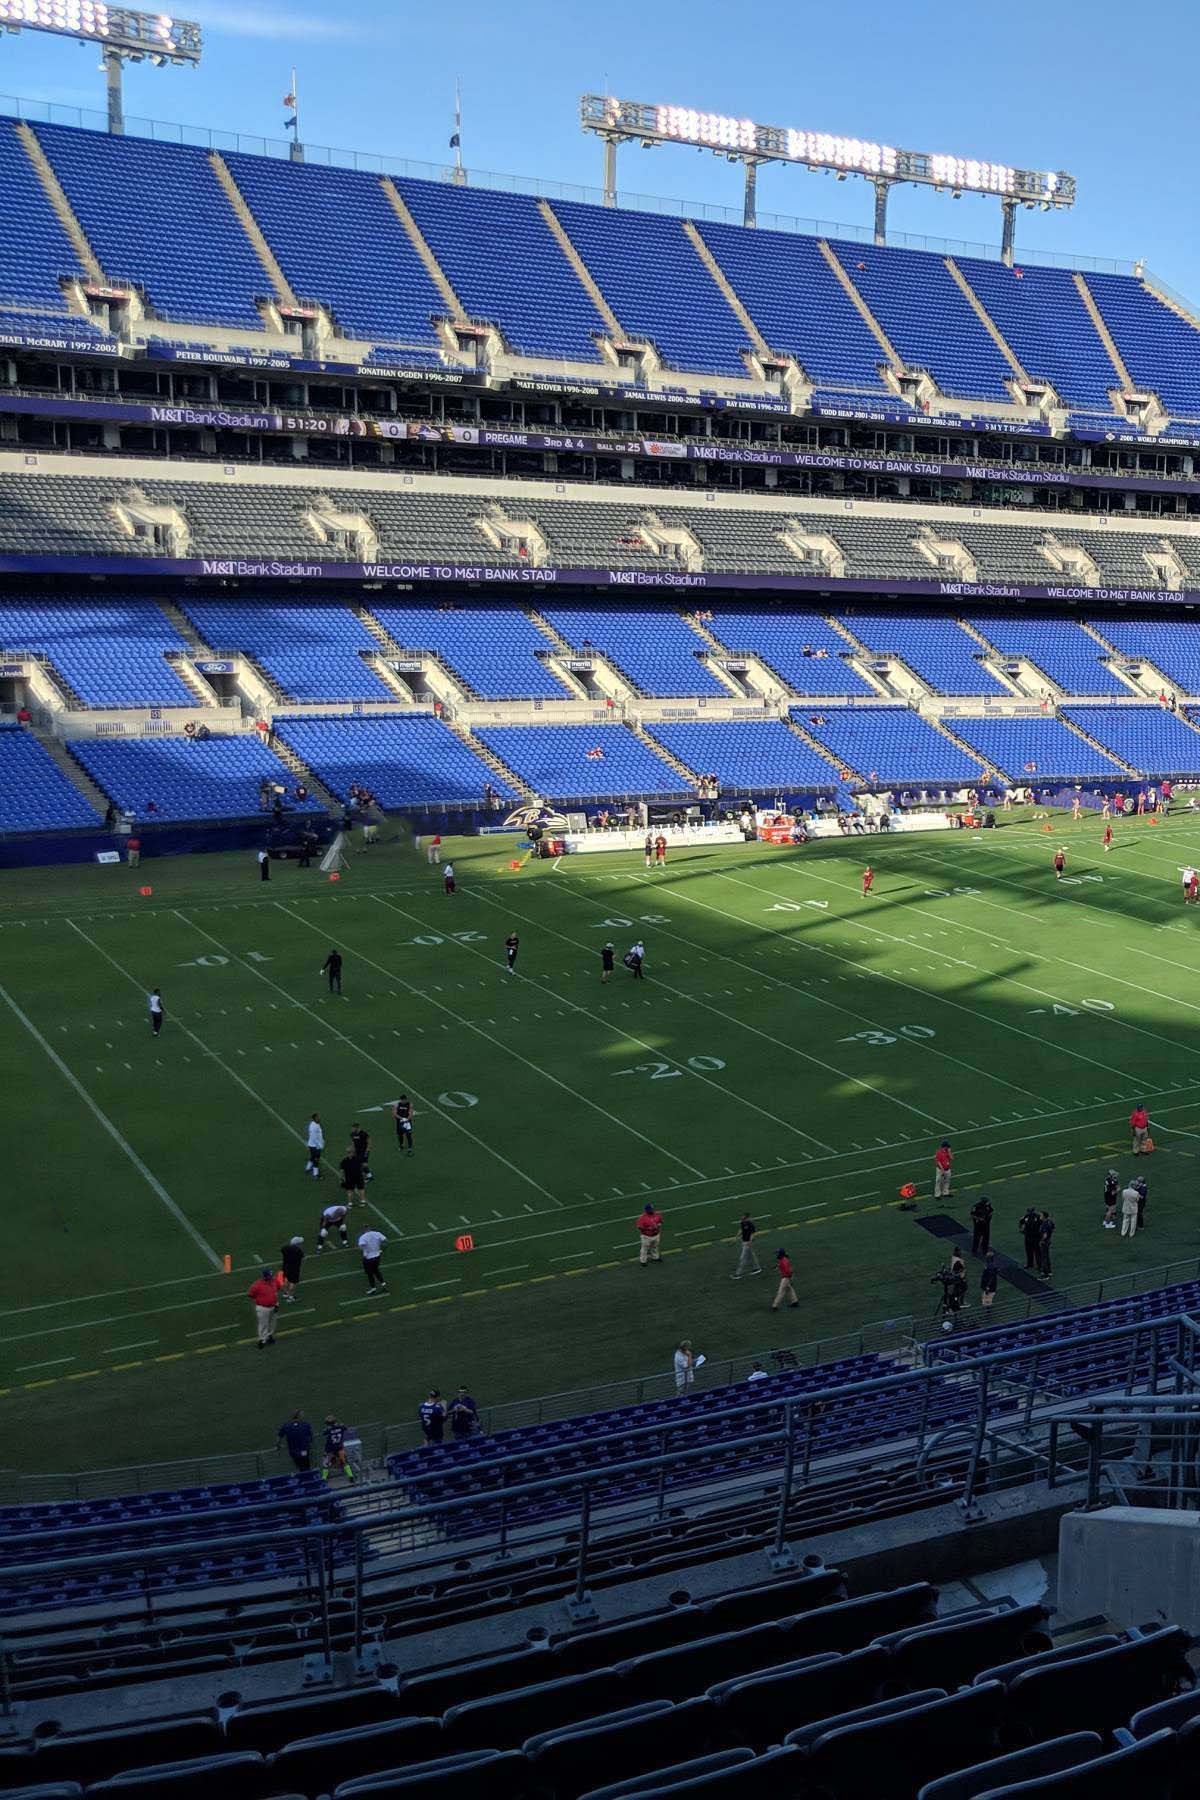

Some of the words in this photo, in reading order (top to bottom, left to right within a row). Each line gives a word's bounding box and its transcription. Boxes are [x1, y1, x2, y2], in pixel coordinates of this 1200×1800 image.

[70, 341, 117, 353] 1997-2002
[176, 350, 202, 361] PETER
[203, 352, 247, 365] BOULWARE
[248, 357, 291, 369] 1997-2005
[357, 366, 396, 379] JONATHAN
[397, 369, 424, 381] OGDEN
[425, 371, 463, 384] 1996-2007
[516, 380, 535, 391] MATT
[536, 382, 562, 393] STOVER
[563, 384, 599, 396] 1996-2008
[624, 390, 645, 401] JAMAL
[646, 392, 667, 402] LEWIS
[668, 394, 702, 406] 2000-2006
[726, 399, 737, 409] RAY
[738, 401, 757, 411] LEWIS
[758, 402, 788, 413] 1996-2012
[820, 408, 837, 417] TODD
[151, 407, 185, 422] M&T
[186, 409, 217, 426] Bank
[218, 410, 268, 429] Stadium
[287, 416, 327, 432] 51:20
[388, 421, 399, 437] 0
[462, 429, 472, 442] 0
[985, 423, 1015, 433] SMYTH
[485, 432, 528, 446] PREGAME
[544, 436, 563, 449] 3RD
[564, 437, 575, 449] &
[576, 437, 585, 450] 4
[1137, 436, 1157, 445] WORLD
[1158, 437, 1190, 447] CHAMPIONS
[627, 442, 641, 453] 25
[694, 446, 719, 459] M&T
[719, 448, 743, 461] Bank
[743, 449, 782, 465] Stadium
[795, 454, 845, 469] WELCOME
[848, 458, 861, 470] TO
[863, 459, 885, 471] M&T
[886, 460, 913, 474] BANK
[914, 462, 942, 475] STADI
[966, 466, 988, 479] M&T
[988, 468, 1009, 482] Bank
[1008, 470, 1042, 484] Stadium
[203, 560, 237, 575] M&T
[238, 563, 270, 576] Bank
[271, 562, 322, 577] Stadium
[363, 565, 431, 579] WELCOME
[434, 567, 452, 579] TO
[454, 568, 483, 580] M&T
[485, 568, 520, 581] BANK
[522, 569, 557, 582] STADI
[609, 571, 638, 584] M&T
[638, 573, 664, 585] Bank
[664, 573, 706, 587] Stadium
[940, 582, 964, 595] M&T
[964, 583, 985, 596] Bank
[985, 584, 1021, 597] Stadium
[1047, 587, 1093, 599] WELCOME
[1095, 588, 1108, 600] TO
[1109, 589, 1129, 600] M&T
[1130, 590, 1156, 601] BANK
[1157, 591, 1184, 602] STADI
[461, 1237, 472, 1251] 10
[423, 1413, 432, 1426] 5
